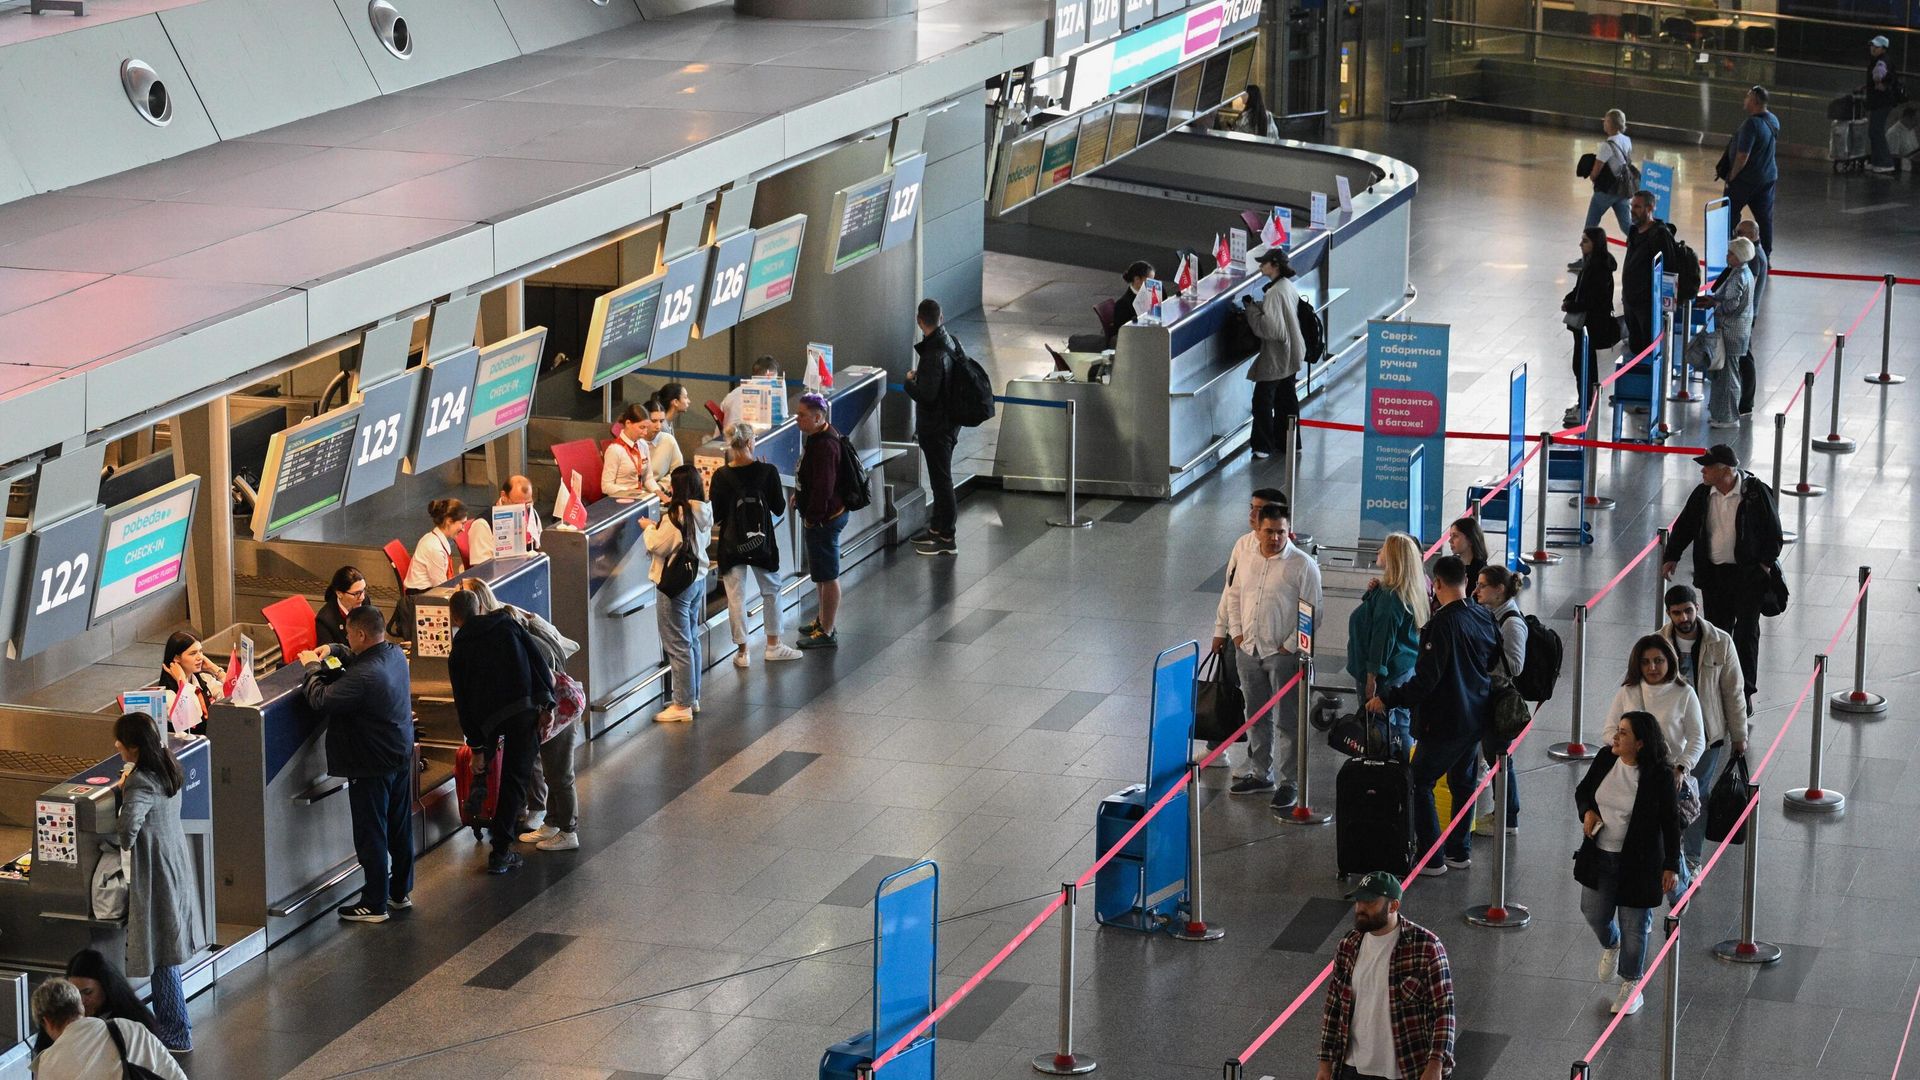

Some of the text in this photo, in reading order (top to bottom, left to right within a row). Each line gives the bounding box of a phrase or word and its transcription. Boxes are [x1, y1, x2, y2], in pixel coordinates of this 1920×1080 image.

[1057, 2, 1084, 39] 127A
[890, 183, 919, 222] 127
[712, 262, 745, 307] 126
[660, 284, 695, 330] 125
[1381, 330, 1417, 342] Сверх-
[1380, 345, 1441, 356] габаритная
[1380, 359, 1418, 369] ручная
[1379, 373, 1411, 382] кладь
[1379, 396, 1433, 406] провозится
[426, 386, 467, 437] 124
[1378, 408, 1410, 416] только
[1386, 418, 1424, 428] багаже!
[357, 413, 401, 466] 123
[1366, 498, 1408, 510] pobed
[125, 537, 165, 565] CHECK-IN
[36, 552, 89, 616] 122
